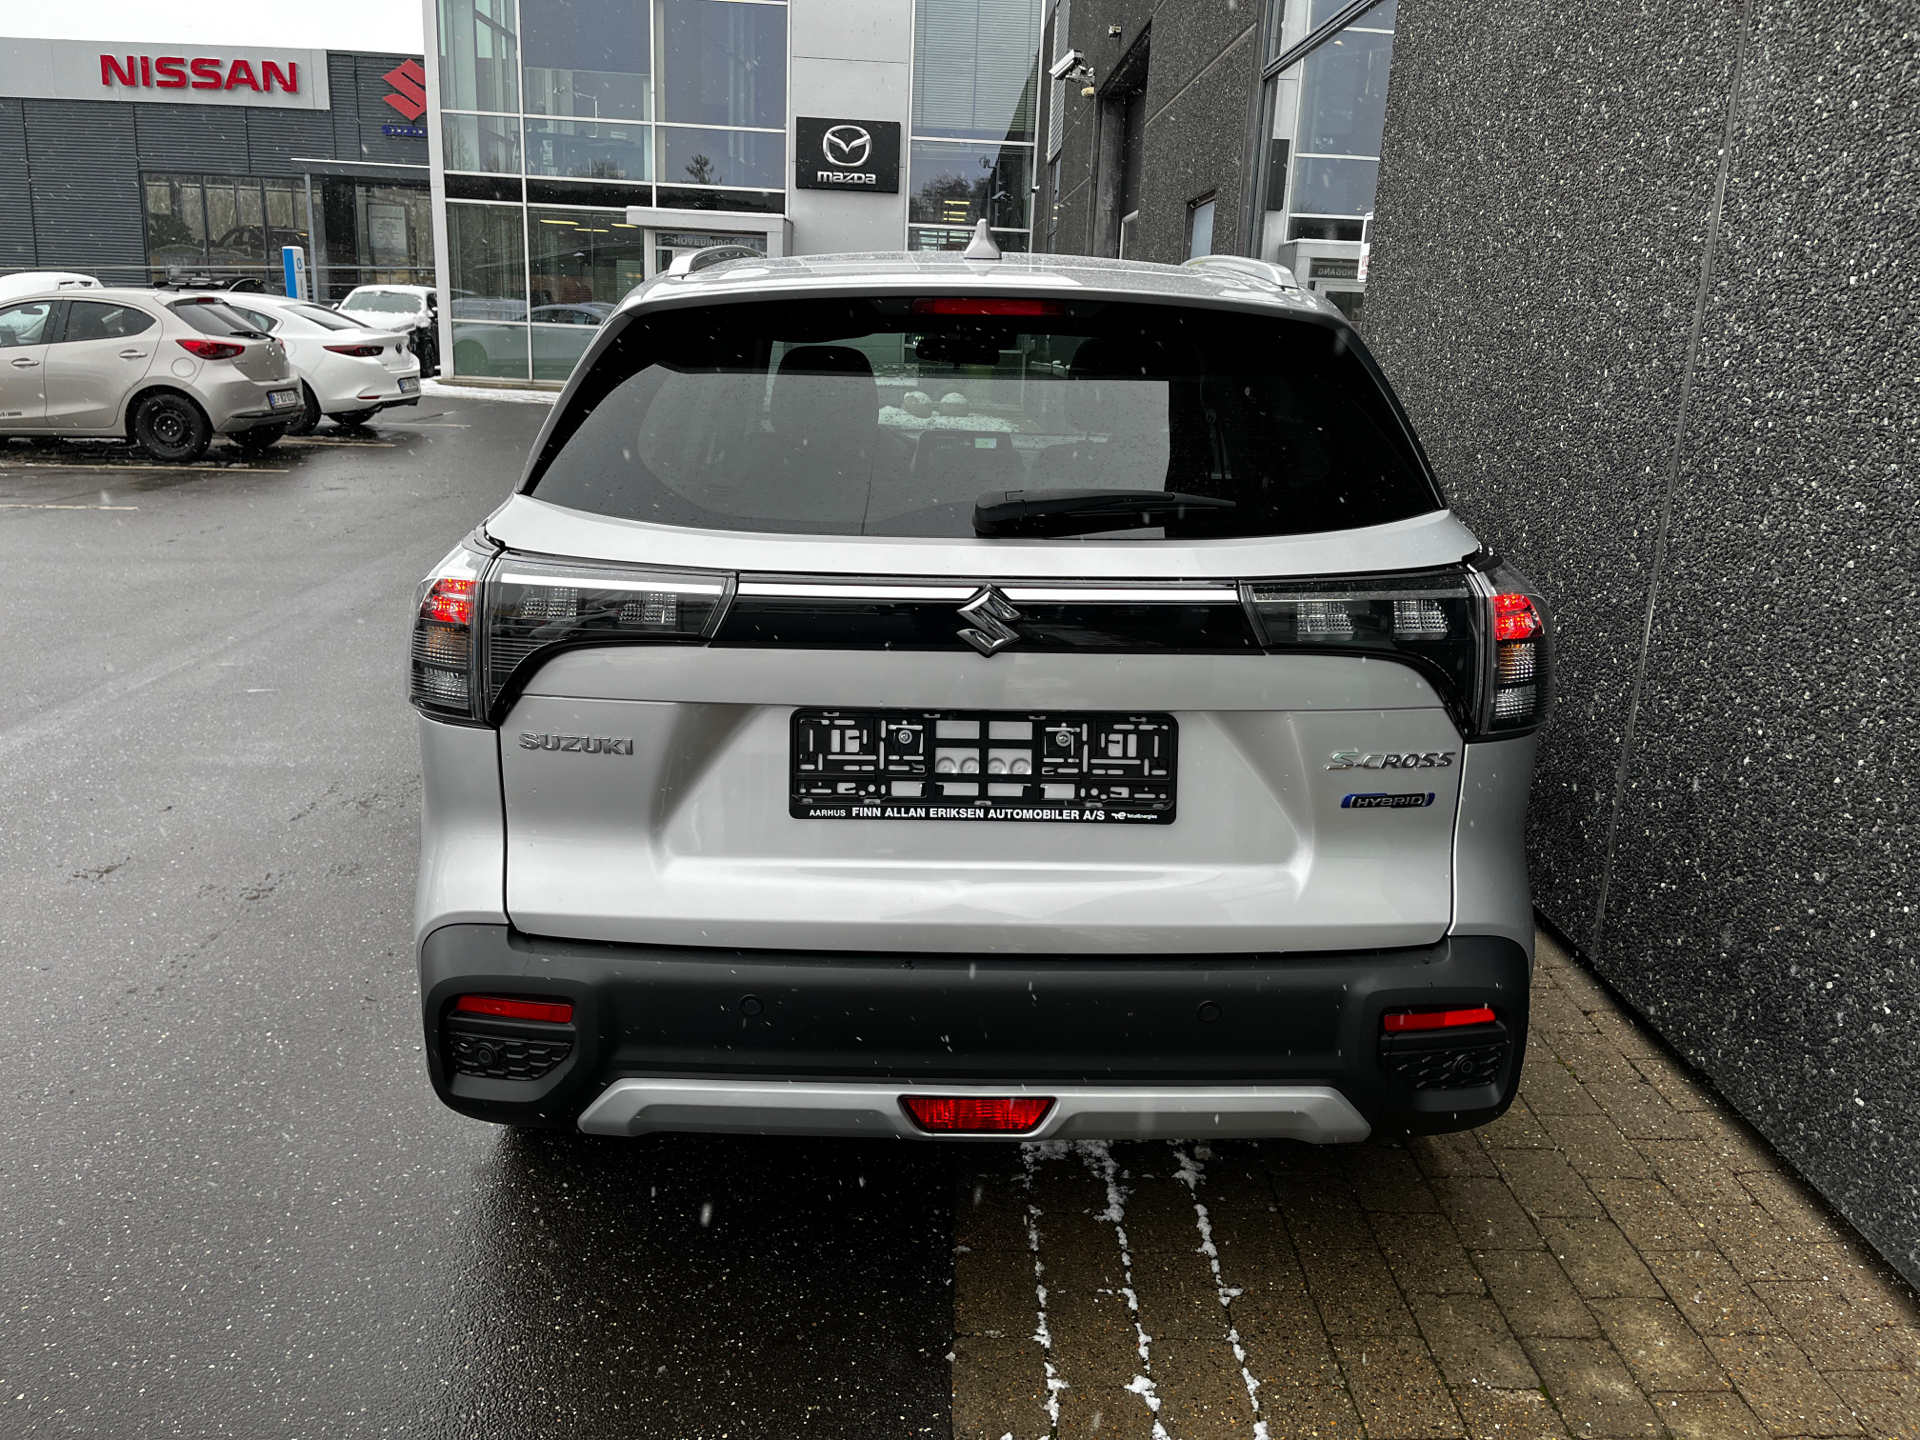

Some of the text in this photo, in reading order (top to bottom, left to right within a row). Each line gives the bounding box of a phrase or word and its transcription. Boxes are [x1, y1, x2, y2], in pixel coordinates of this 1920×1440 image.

[100, 54, 298, 93] NISSAN
[518, 731, 634, 755] SUZUKI
[1356, 795, 1423, 807] HYBRID
[809, 808, 846, 817] AARHUS
[852, 806, 881, 817] FINN
[884, 807, 925, 818] ALLAN
[930, 807, 984, 819] ERIKSEN
[988, 808, 1079, 820] AUTOMOBILER
[1083, 810, 1105, 821] A/S
